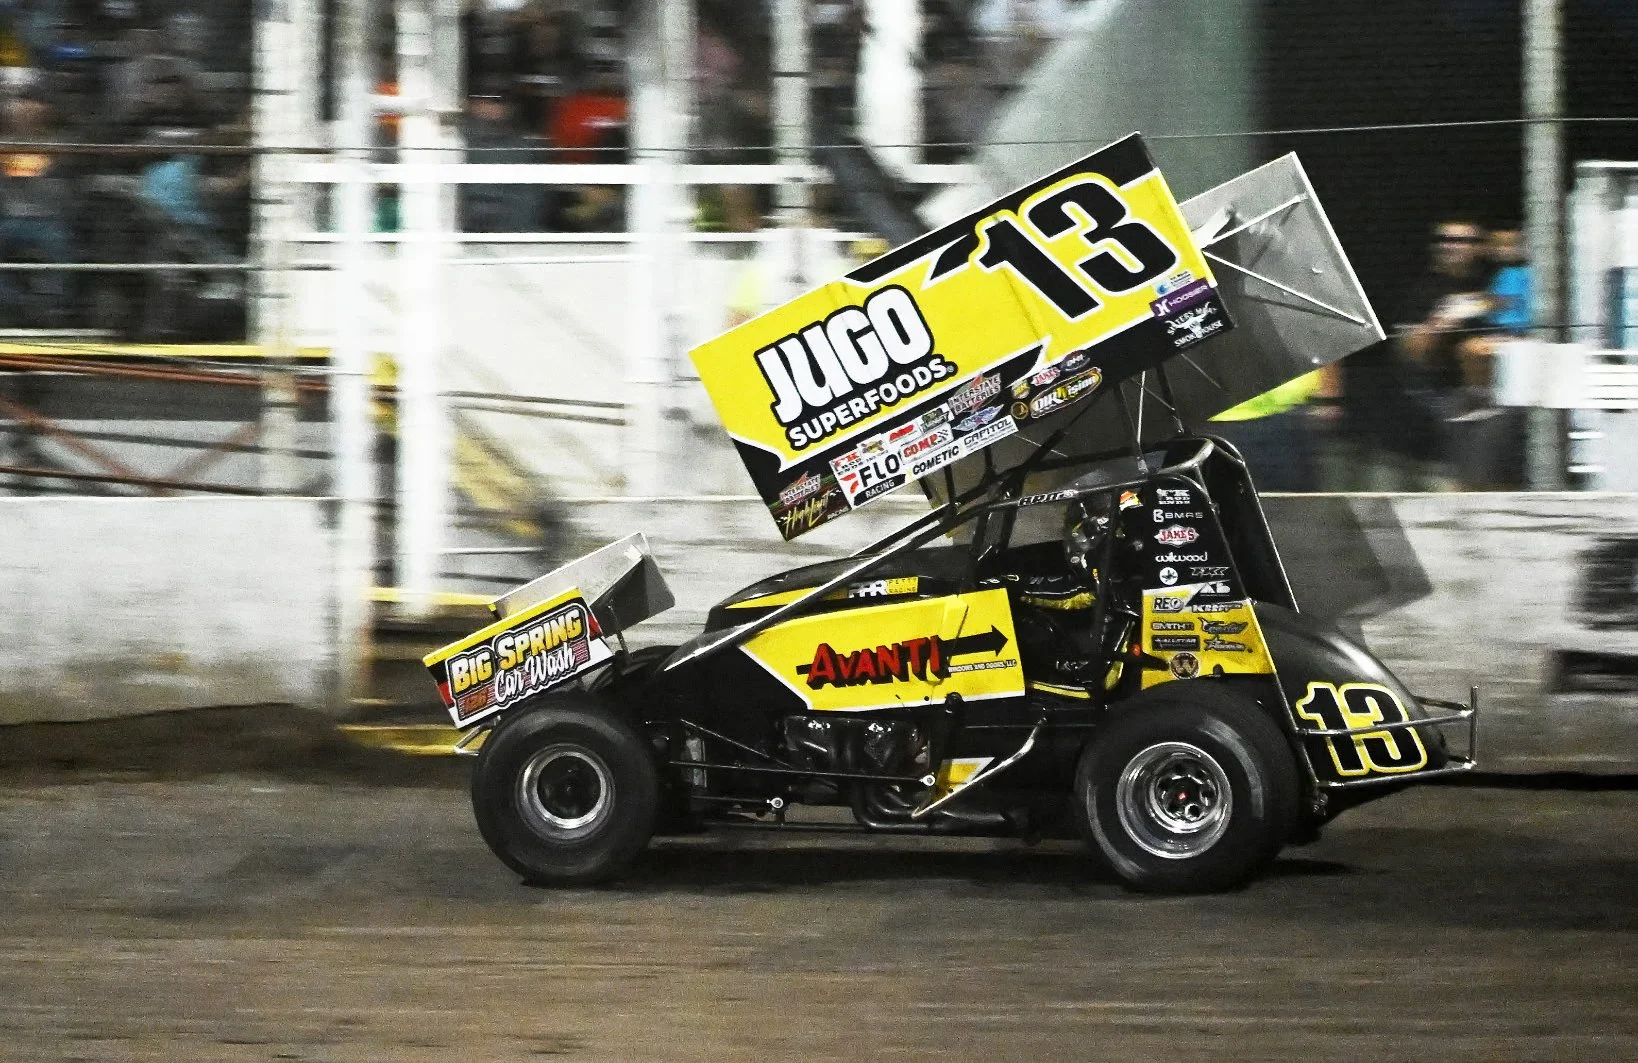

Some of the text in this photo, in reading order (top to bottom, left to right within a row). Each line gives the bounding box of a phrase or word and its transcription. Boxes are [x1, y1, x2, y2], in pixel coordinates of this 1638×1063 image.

[976, 179, 1180, 322] 13
[1168, 285, 1208, 306] HOOSIER
[755, 285, 934, 424] JUGO
[787, 356, 948, 449] SUPERFOODS
[903, 433, 938, 458] COMP
[963, 419, 1012, 446] CAPITOL
[859, 453, 900, 488] FLO
[912, 445, 960, 476] COMETIC
[865, 479, 895, 499] RACING
[452, 609, 583, 694] BIG SPRING
[494, 666, 526, 703] Car
[525, 641, 576, 687] Wash
[807, 635, 944, 688] AVANTI
[1299, 683, 1426, 774] 13
